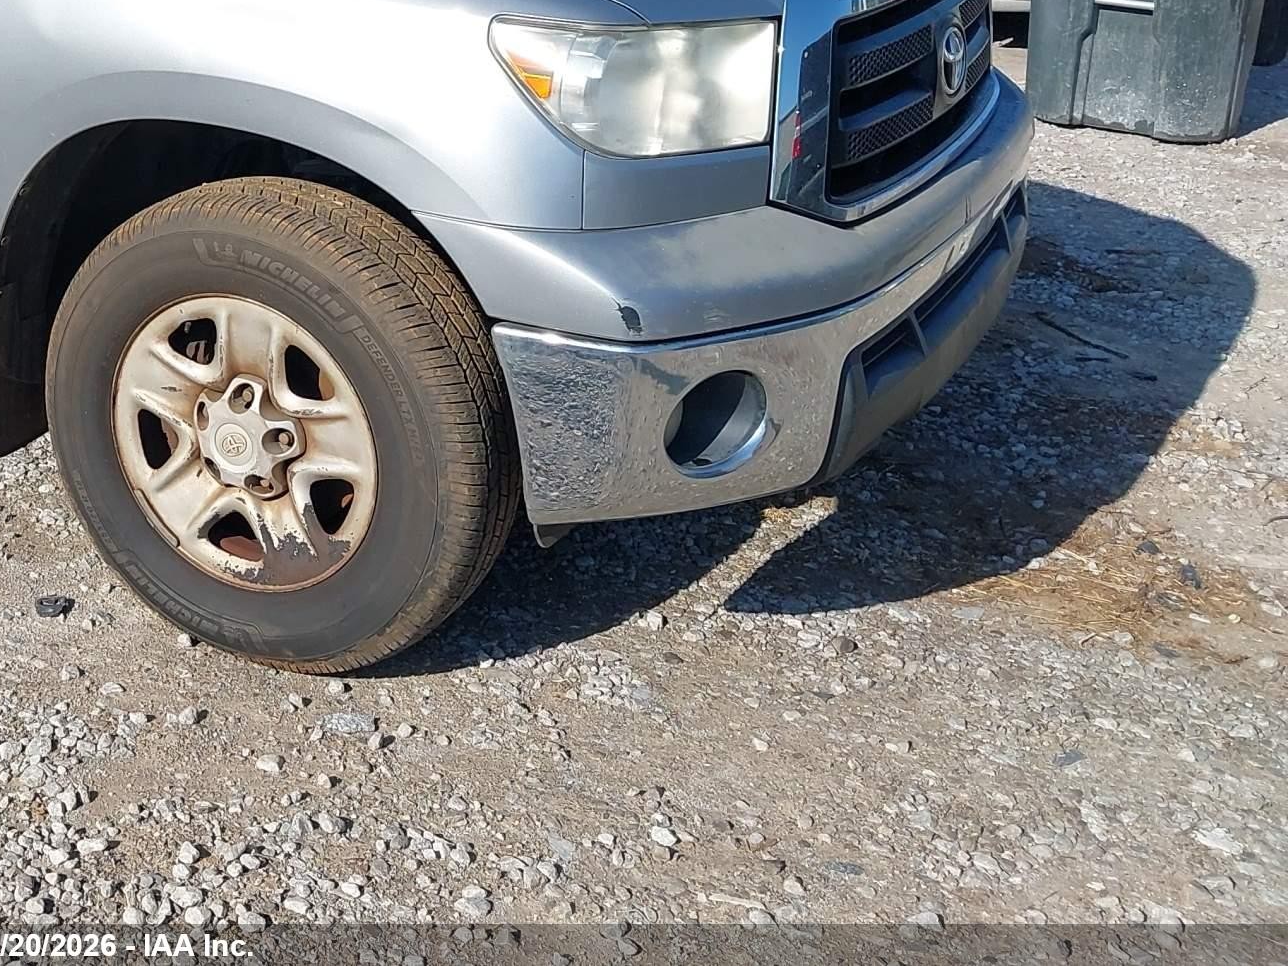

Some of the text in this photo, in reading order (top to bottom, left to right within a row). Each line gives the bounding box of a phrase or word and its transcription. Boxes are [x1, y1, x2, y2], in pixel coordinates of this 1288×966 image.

[240, 249, 347, 319] MICHELIN
[360, 334, 404, 397] DEFENDER
[398, 399, 415, 425] LTX
[124, 564, 220, 635] MICHELIN
